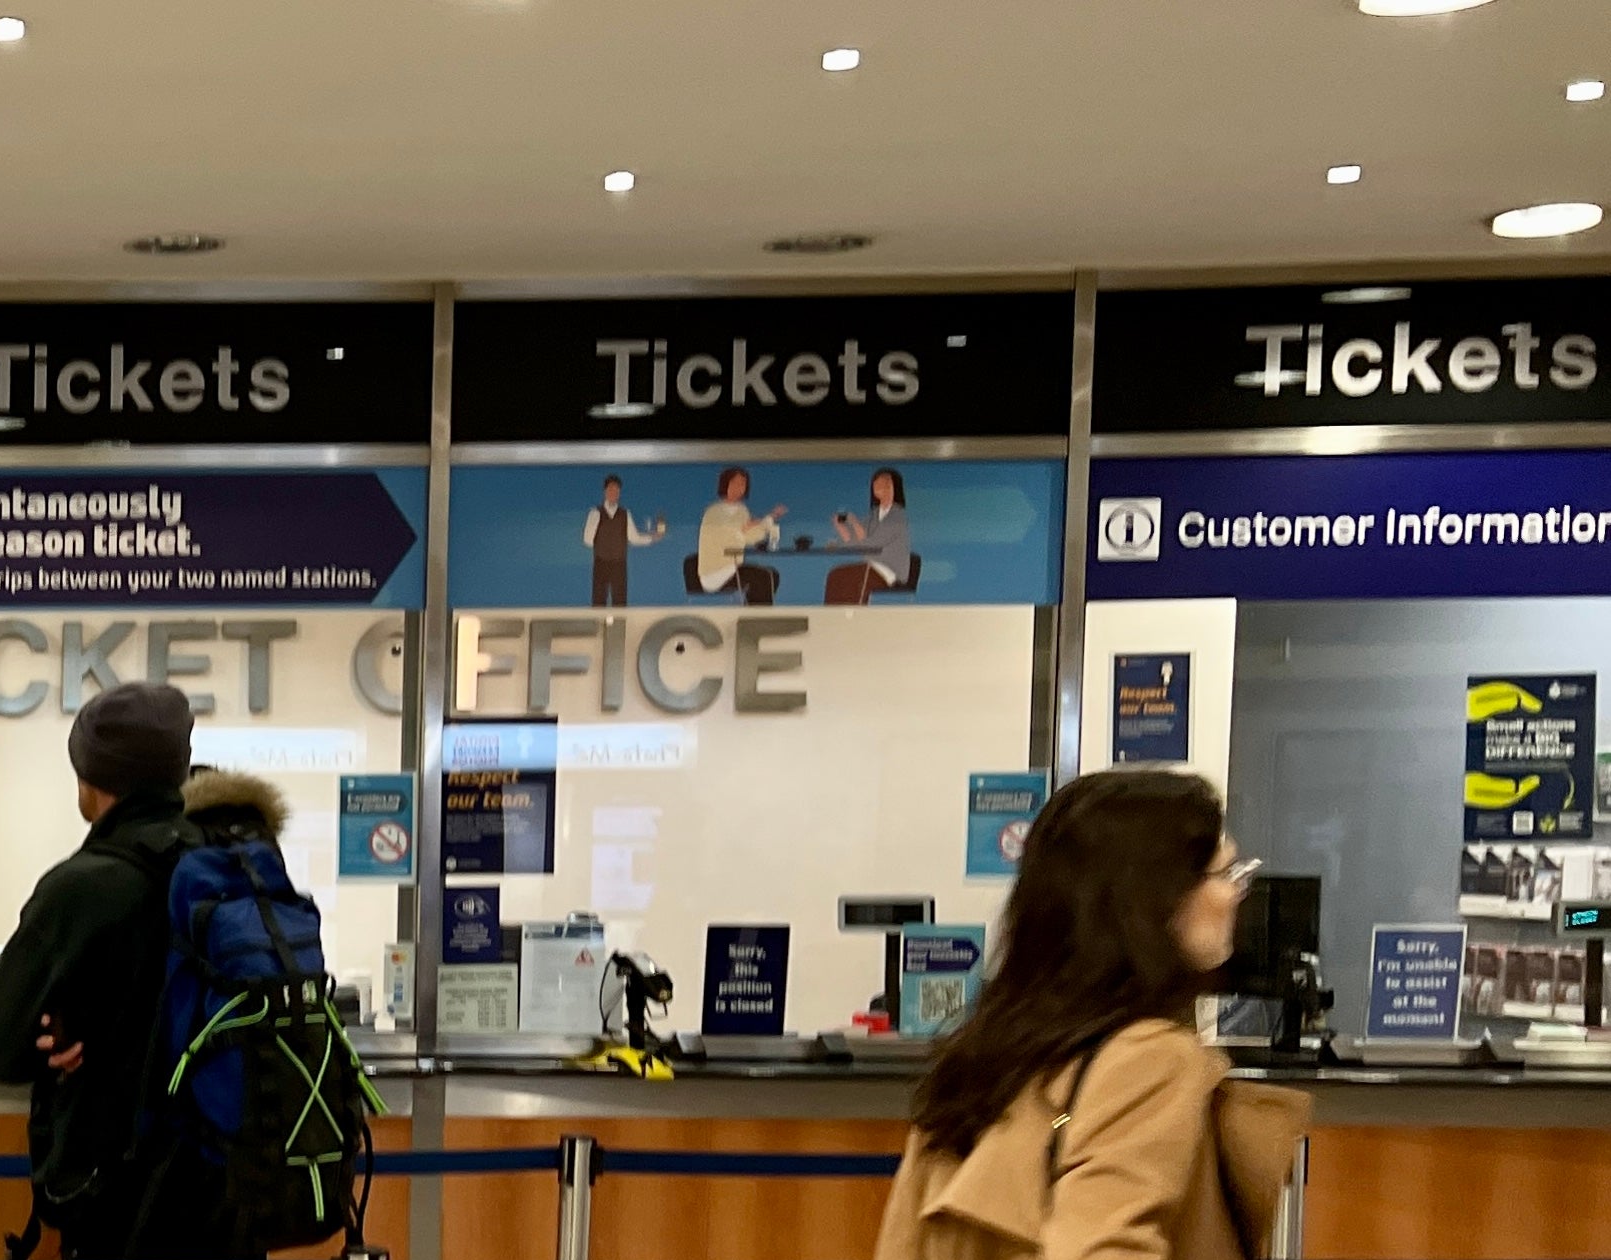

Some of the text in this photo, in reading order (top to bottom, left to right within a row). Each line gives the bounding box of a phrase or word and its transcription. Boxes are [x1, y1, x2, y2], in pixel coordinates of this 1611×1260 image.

[596, 338, 919, 407] Tickets
[1246, 321, 1598, 397] Tickets
[93, 521, 201, 558] ticket.
[1178, 508, 1375, 549] Customer
[38, 565, 121, 591] between
[128, 568, 173, 595] your
[178, 565, 215, 590] two
[220, 565, 287, 590] named
[291, 563, 377, 590] stations.
[448, 768, 520, 789] Respect
[447, 793, 478, 809] our
